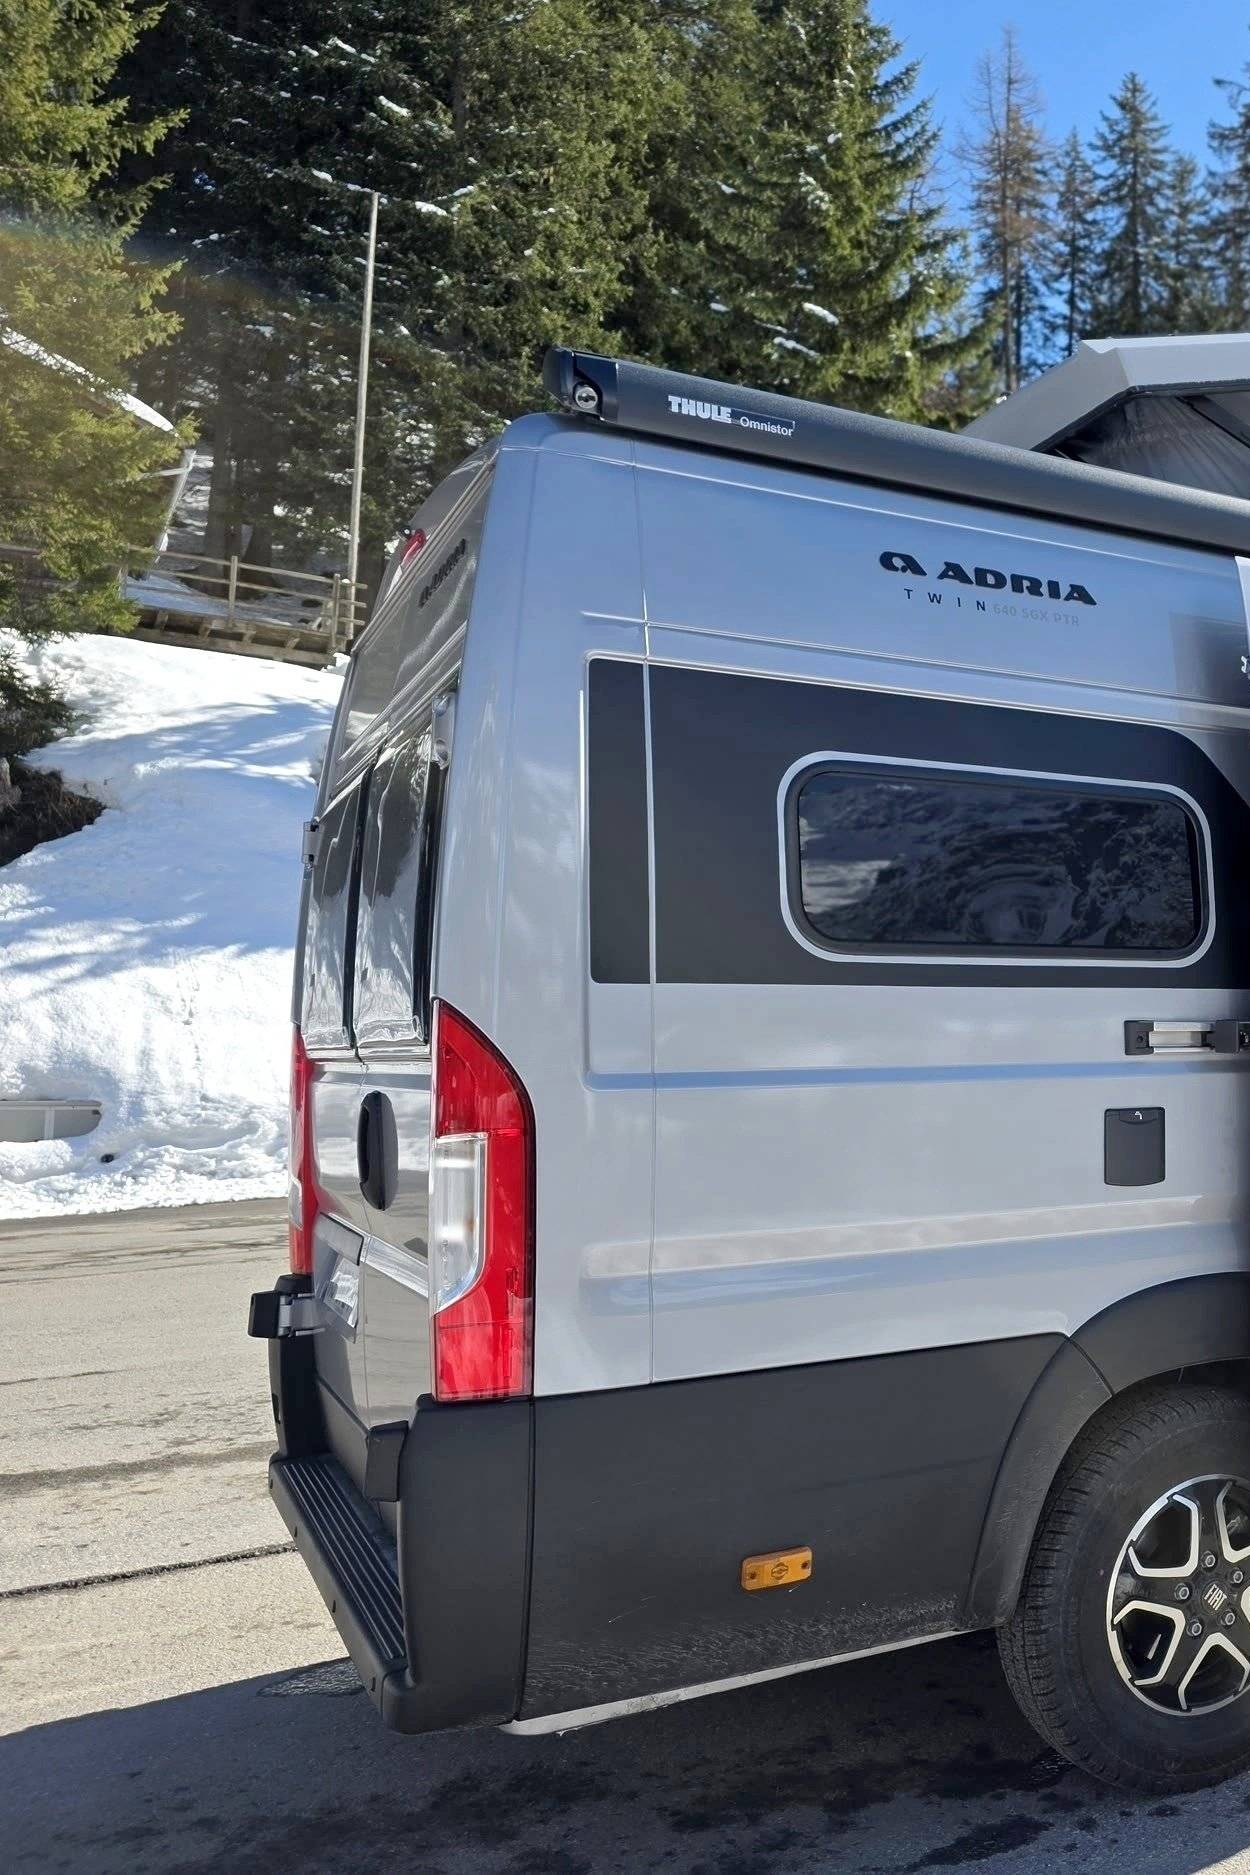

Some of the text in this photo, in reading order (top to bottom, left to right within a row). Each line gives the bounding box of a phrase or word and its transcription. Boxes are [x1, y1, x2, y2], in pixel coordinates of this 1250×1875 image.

[668, 395, 794, 437] THULE Omnistor
[904, 588, 986, 612] TWIN
[937, 561, 1098, 606] ADRIA
[1204, 1583, 1228, 1611] FIAT
